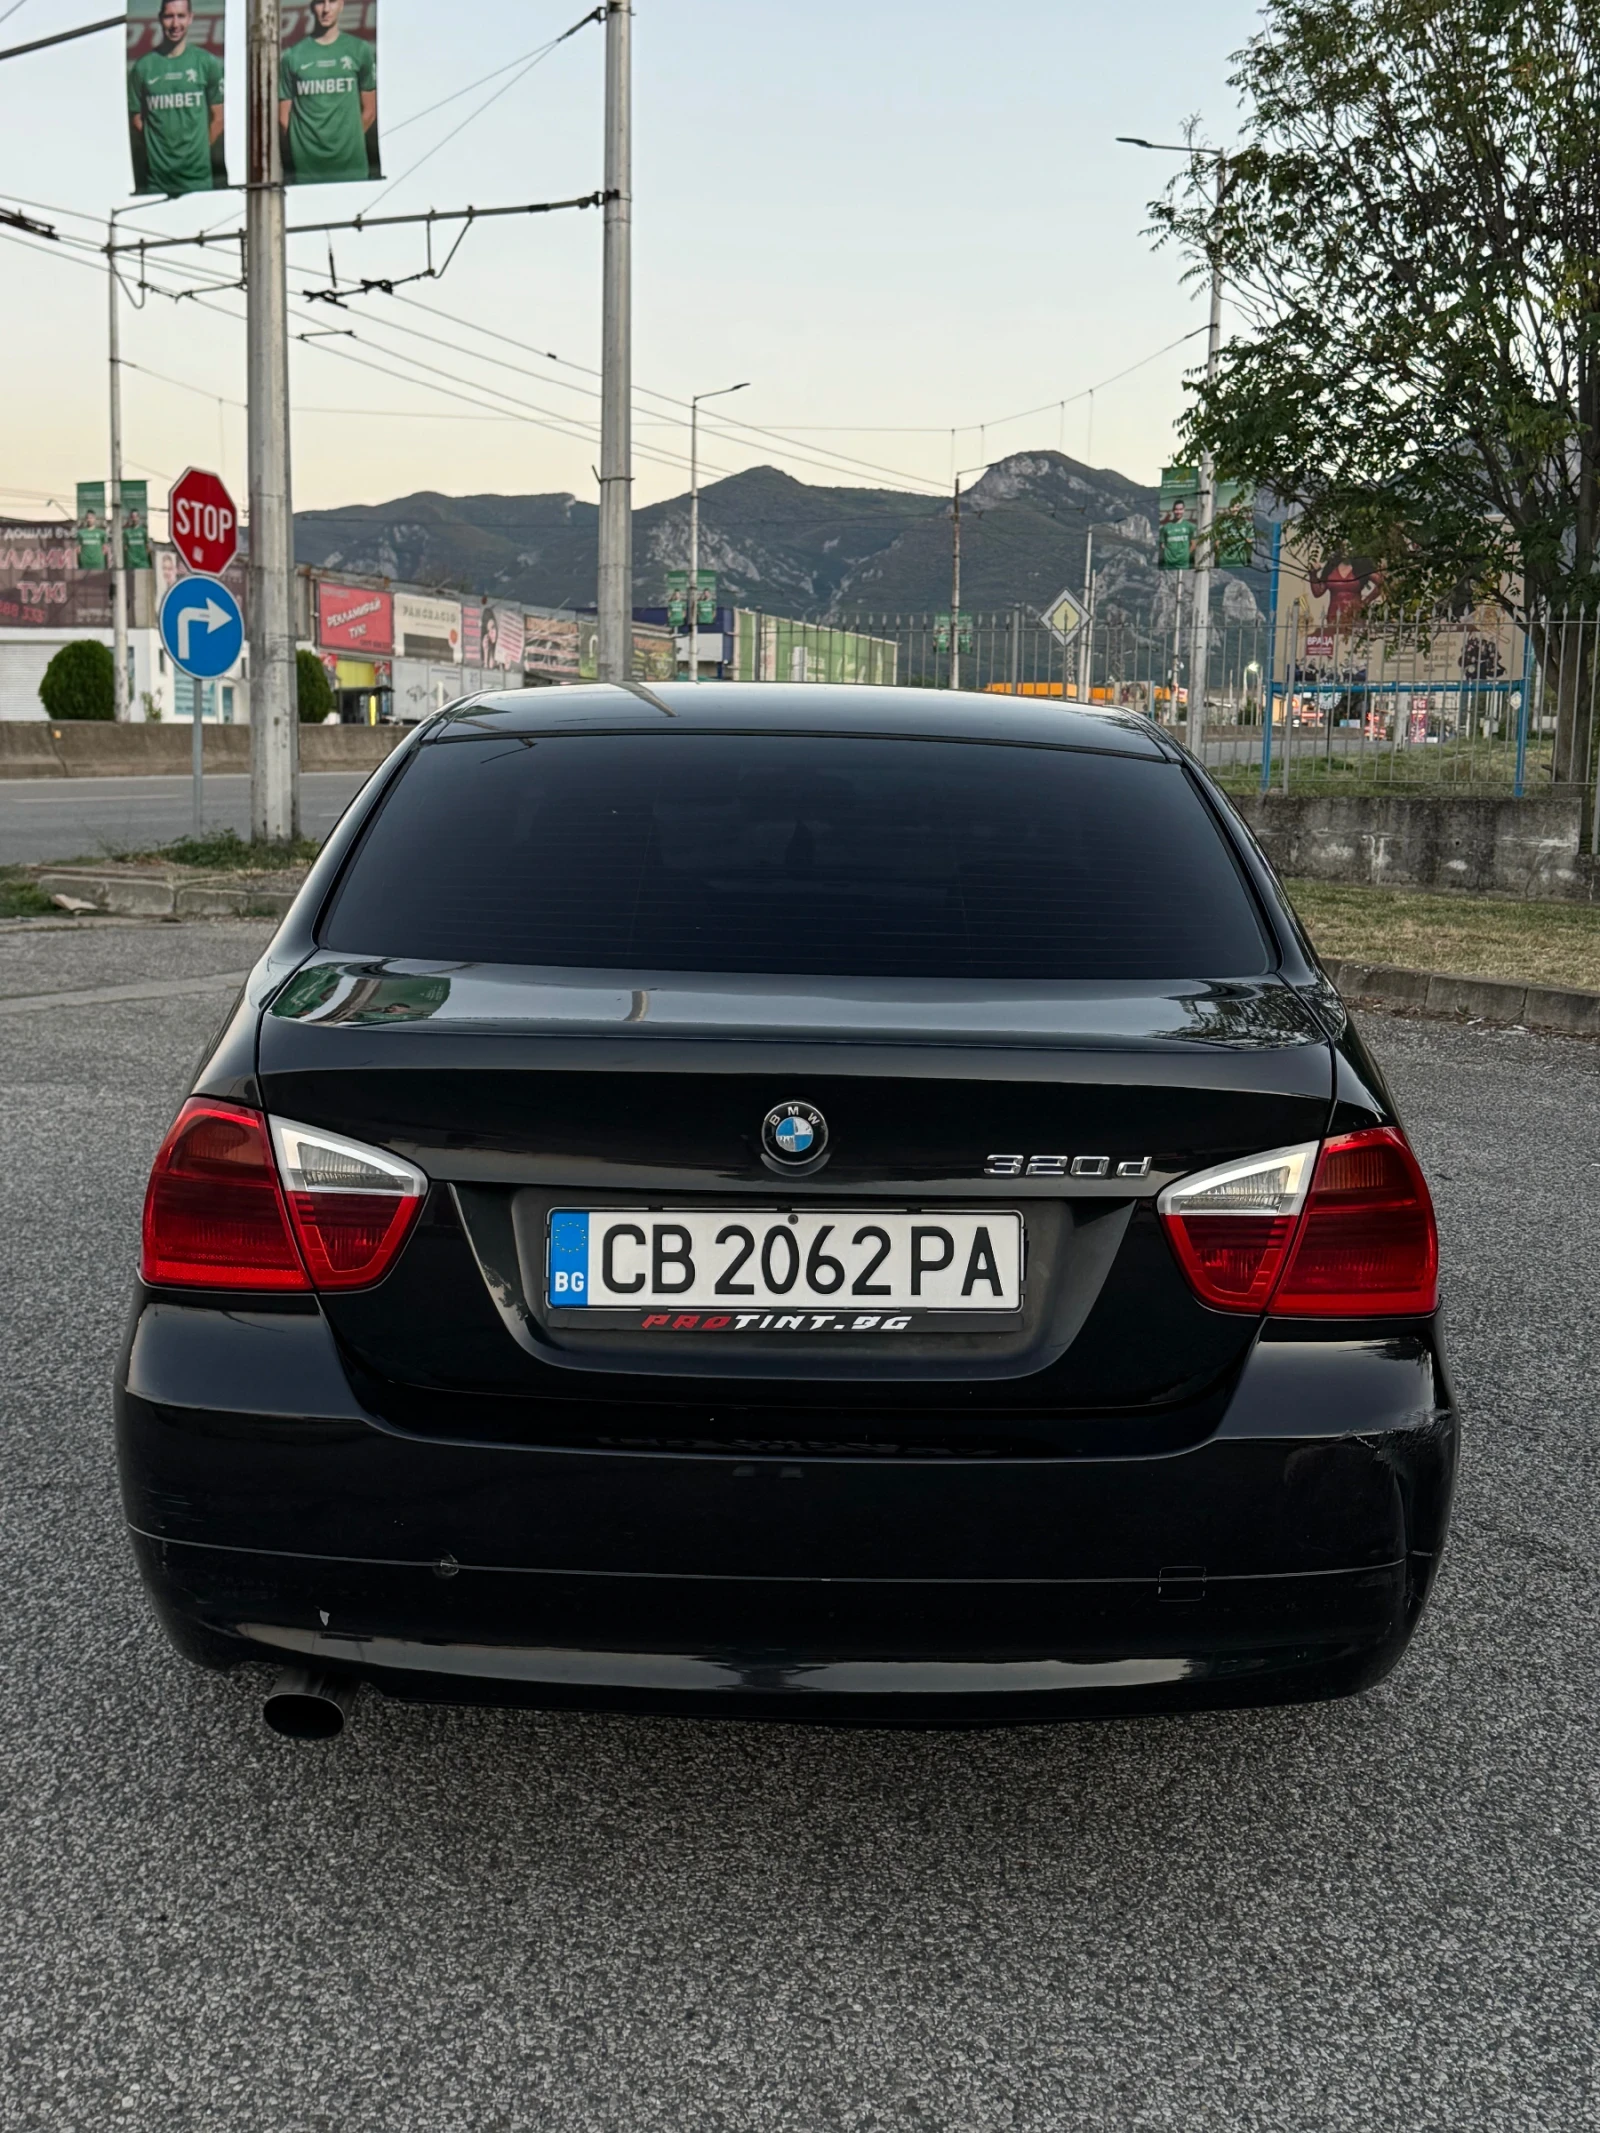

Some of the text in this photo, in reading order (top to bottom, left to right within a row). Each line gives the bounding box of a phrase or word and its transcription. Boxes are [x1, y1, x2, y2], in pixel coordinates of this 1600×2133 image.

[295, 77, 355, 96] WINBET
[146, 90, 204, 110] WINBET
[176, 497, 233, 545] STOP
[1307, 635, 1333, 647] ВРАЦА
[769, 1106, 820, 1126] BMW
[984, 1154, 1152, 1176] 320d
[555, 1271, 584, 1292] BG
[641, 1314, 912, 1331] PROTINT.BG
